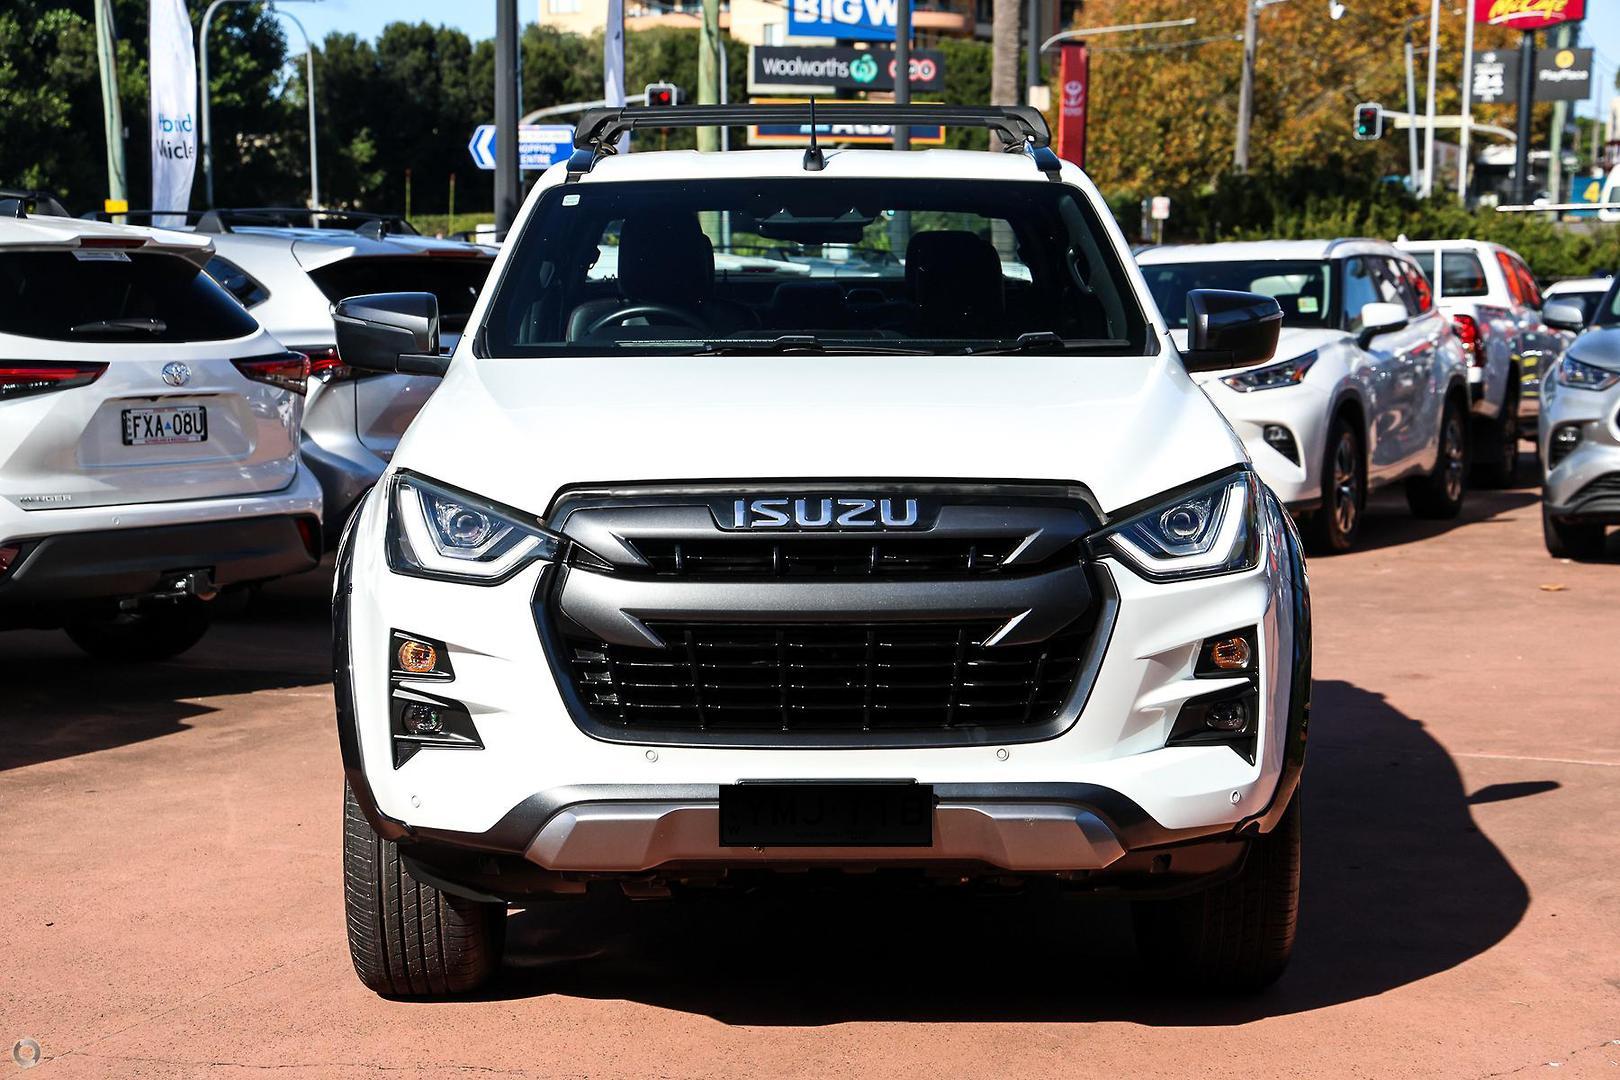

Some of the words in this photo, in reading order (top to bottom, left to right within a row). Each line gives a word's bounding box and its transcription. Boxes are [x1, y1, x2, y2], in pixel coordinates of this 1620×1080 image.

[762, 56, 849, 78] Woolworths
[133, 414, 165, 439] FXA
[173, 411, 203, 435] 08U
[733, 498, 918, 528] ISUZU
